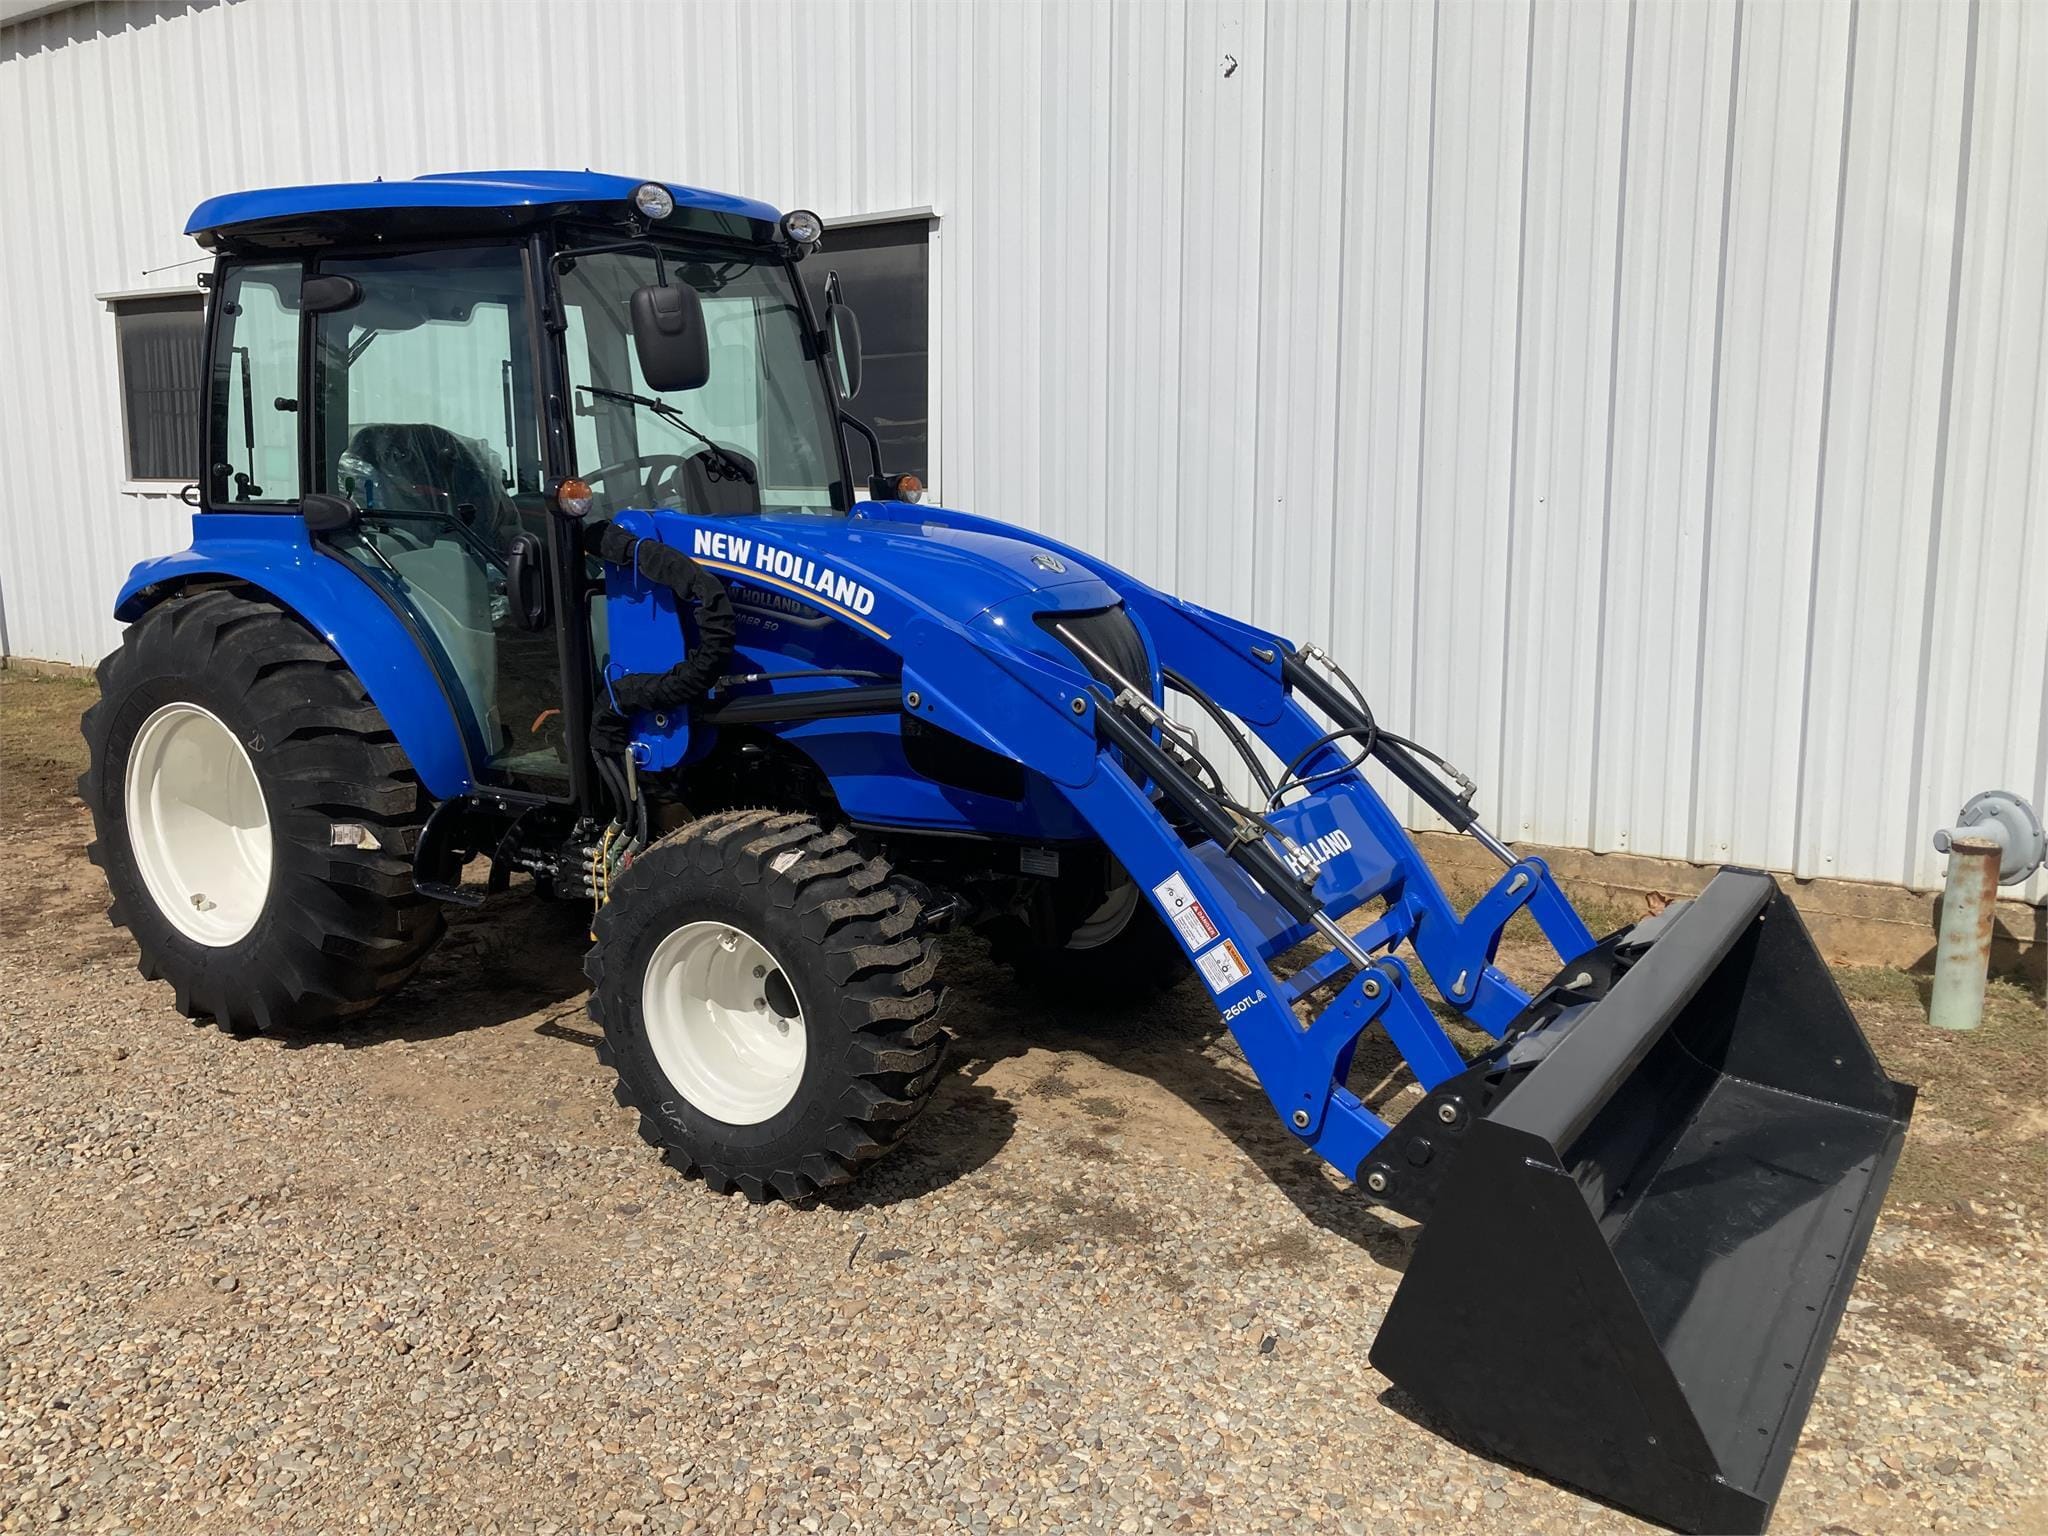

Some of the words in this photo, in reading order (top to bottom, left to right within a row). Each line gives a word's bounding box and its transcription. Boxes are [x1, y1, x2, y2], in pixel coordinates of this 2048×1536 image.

[694, 529, 751, 564] NEW
[756, 543, 875, 616] HOLLAND
[742, 589, 801, 613] HOLLAND
[1282, 829, 1352, 876] HLLAND
[1222, 989, 1267, 1021] 260TLA
